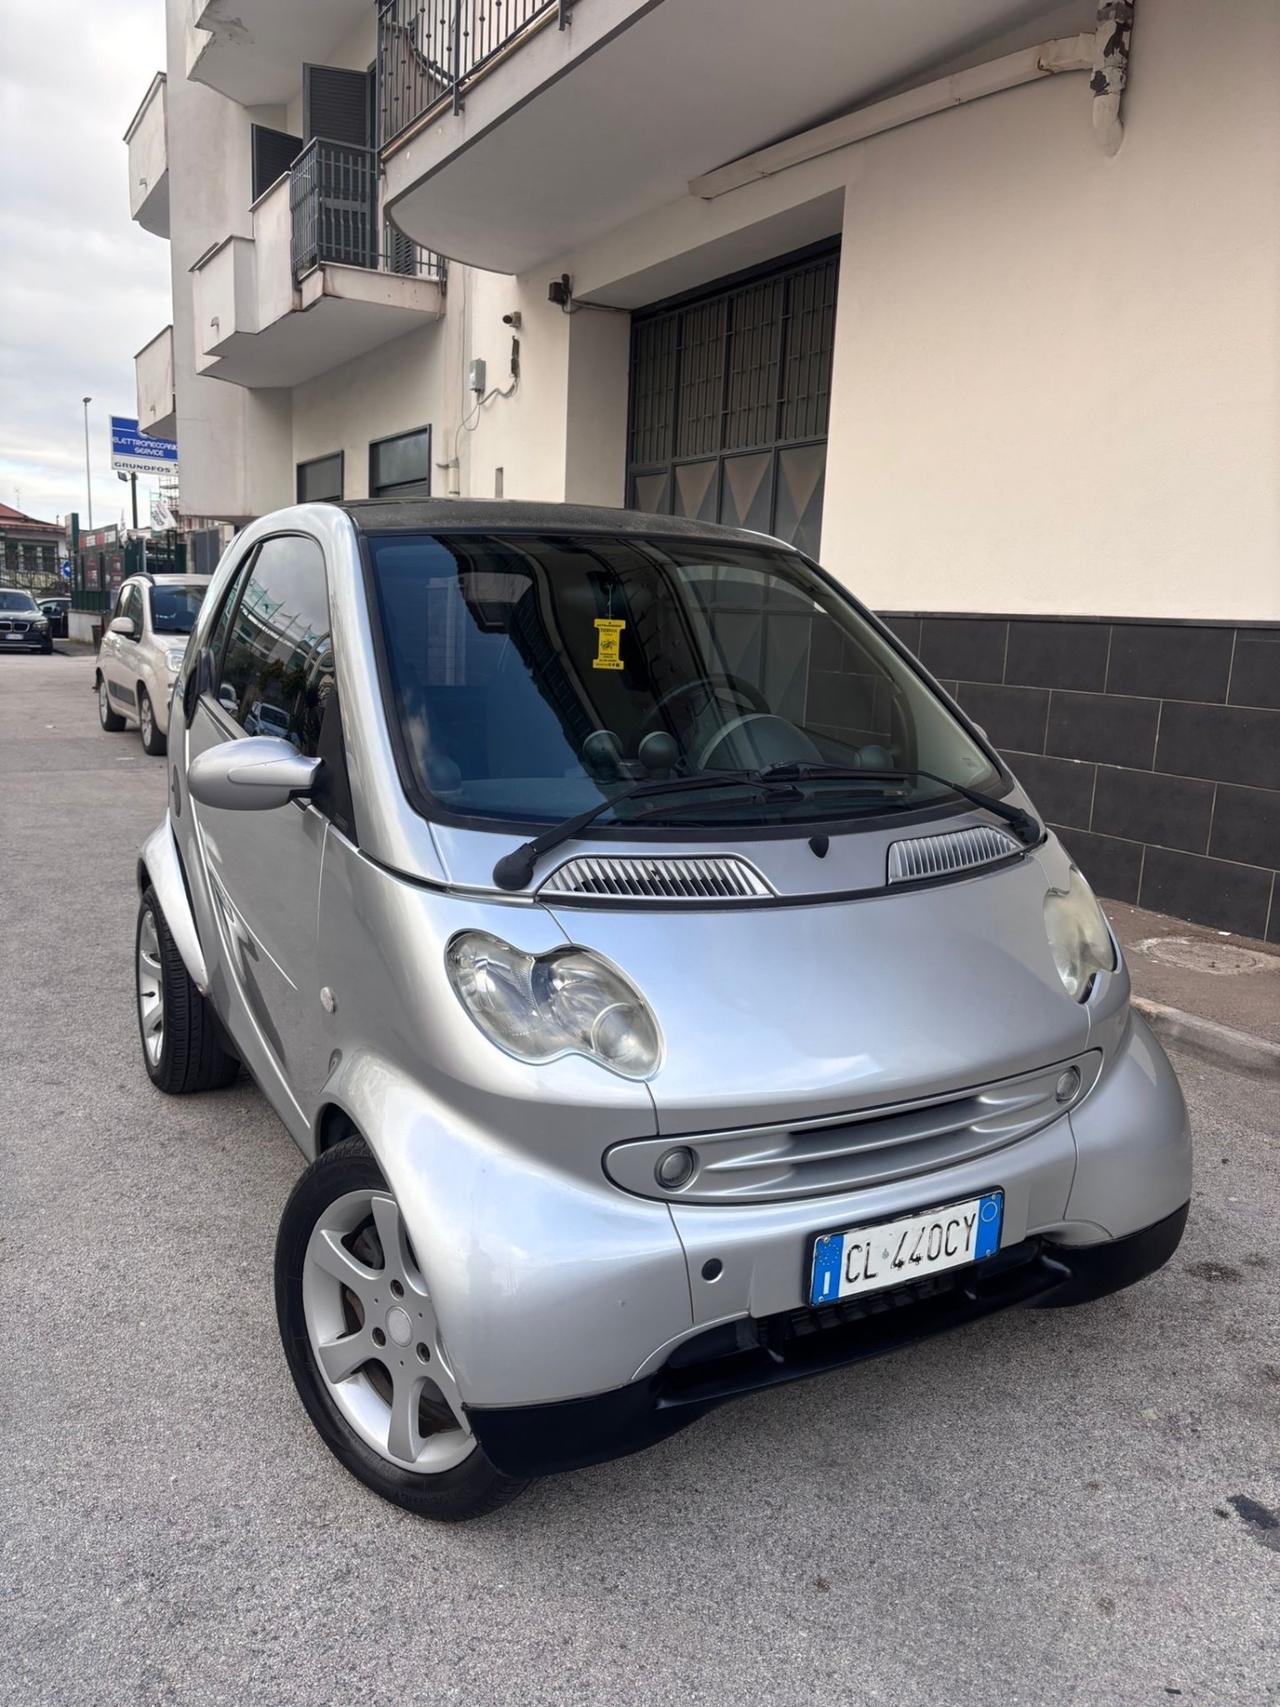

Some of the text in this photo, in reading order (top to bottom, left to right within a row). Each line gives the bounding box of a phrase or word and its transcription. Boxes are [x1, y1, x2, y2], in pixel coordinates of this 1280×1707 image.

[134, 447, 164, 457] SERVICE
[114, 461, 171, 473] GRUNDFOS
[845, 1242, 877, 1284] CL
